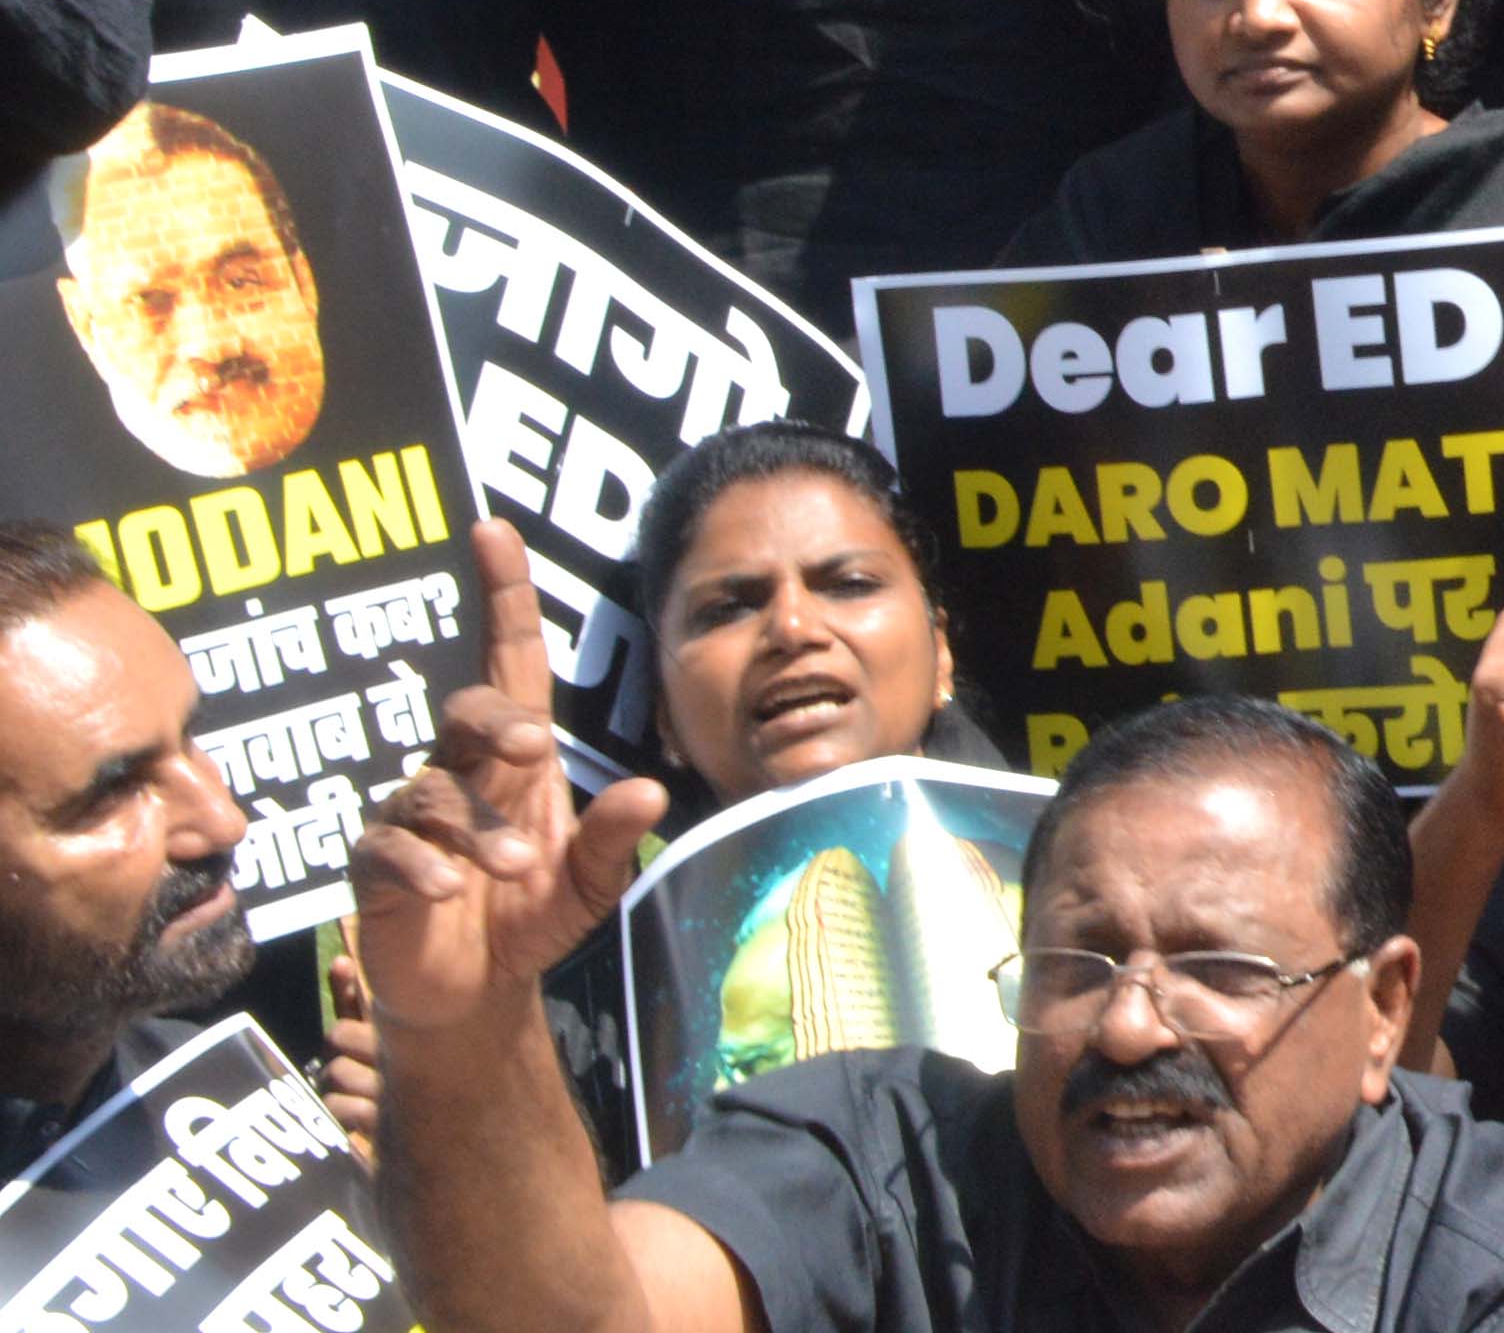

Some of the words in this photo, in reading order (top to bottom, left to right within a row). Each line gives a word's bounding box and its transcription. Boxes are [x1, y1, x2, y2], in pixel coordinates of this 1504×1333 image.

[932, 302, 1287, 419] Dear
[466, 360, 660, 563] ED
[953, 454, 1249, 550] DARO
[1032, 555, 1352, 671] Adani
[1362, 554, 1497, 644] पर
